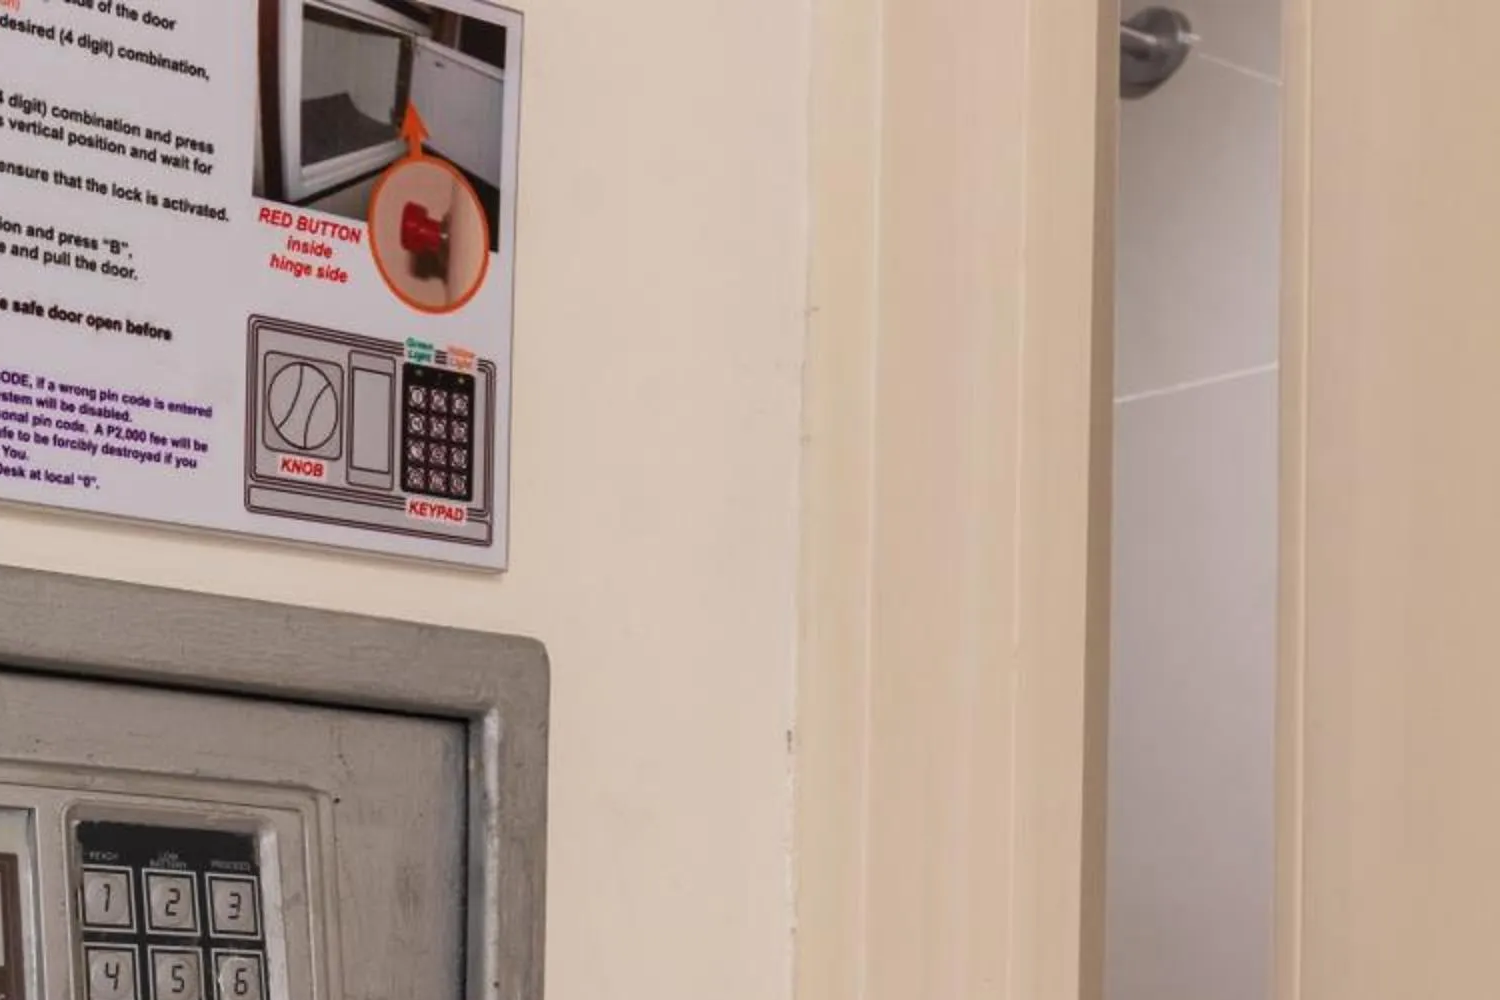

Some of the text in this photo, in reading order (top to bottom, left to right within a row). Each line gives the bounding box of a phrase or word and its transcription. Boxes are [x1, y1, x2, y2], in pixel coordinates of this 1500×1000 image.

[97, 0, 113, 13] of
[115, 3, 139, 21] the
[141, 10, 177, 30] door
[59, 28, 74, 45] (4
[77, 33, 115, 58] digit)
[117, 46, 211, 81] combination,
[7, 93, 48, 117] digit)
[51, 105, 141, 136] combination
[144, 127, 173, 144] and
[175, 135, 215, 154] press
[8, 118, 65, 140] vertical
[67, 131, 127, 155] position
[129, 146, 157, 162] and
[160, 152, 190, 170] wait
[192, 157, 213, 175] for
[53, 170, 83, 189] that
[85, 177, 109, 195] the
[111, 183, 143, 202] lock
[145, 190, 159, 206] is
[161, 197, 230, 222] activated.
[25, 225, 55, 240] and
[57, 231, 99, 250] press
[259, 207, 362, 244] RED BUTTON
[9, 243, 39, 260] and
[42, 251, 71, 266] pull
[74, 255, 98, 272] the
[100, 260, 139, 281] door.
[287, 235, 332, 258] inside
[269, 253, 349, 283] hinge side
[12, 300, 44, 317] safe
[47, 304, 83, 324] door
[86, 314, 122, 332] open
[125, 319, 172, 340] before
[31, 415, 53, 427] pin
[94, 423, 104, 435] A
[149, 431, 169, 446] fee
[170, 437, 192, 449] will
[193, 439, 209, 453] be
[29, 469, 42, 480] at
[43, 469, 75, 485] local
[281, 457, 325, 477] KNOB
[408, 501, 464, 522] KEYPAD
[103, 883, 242, 920] 1 2 3
[105, 962, 248, 995] 4 5 6
